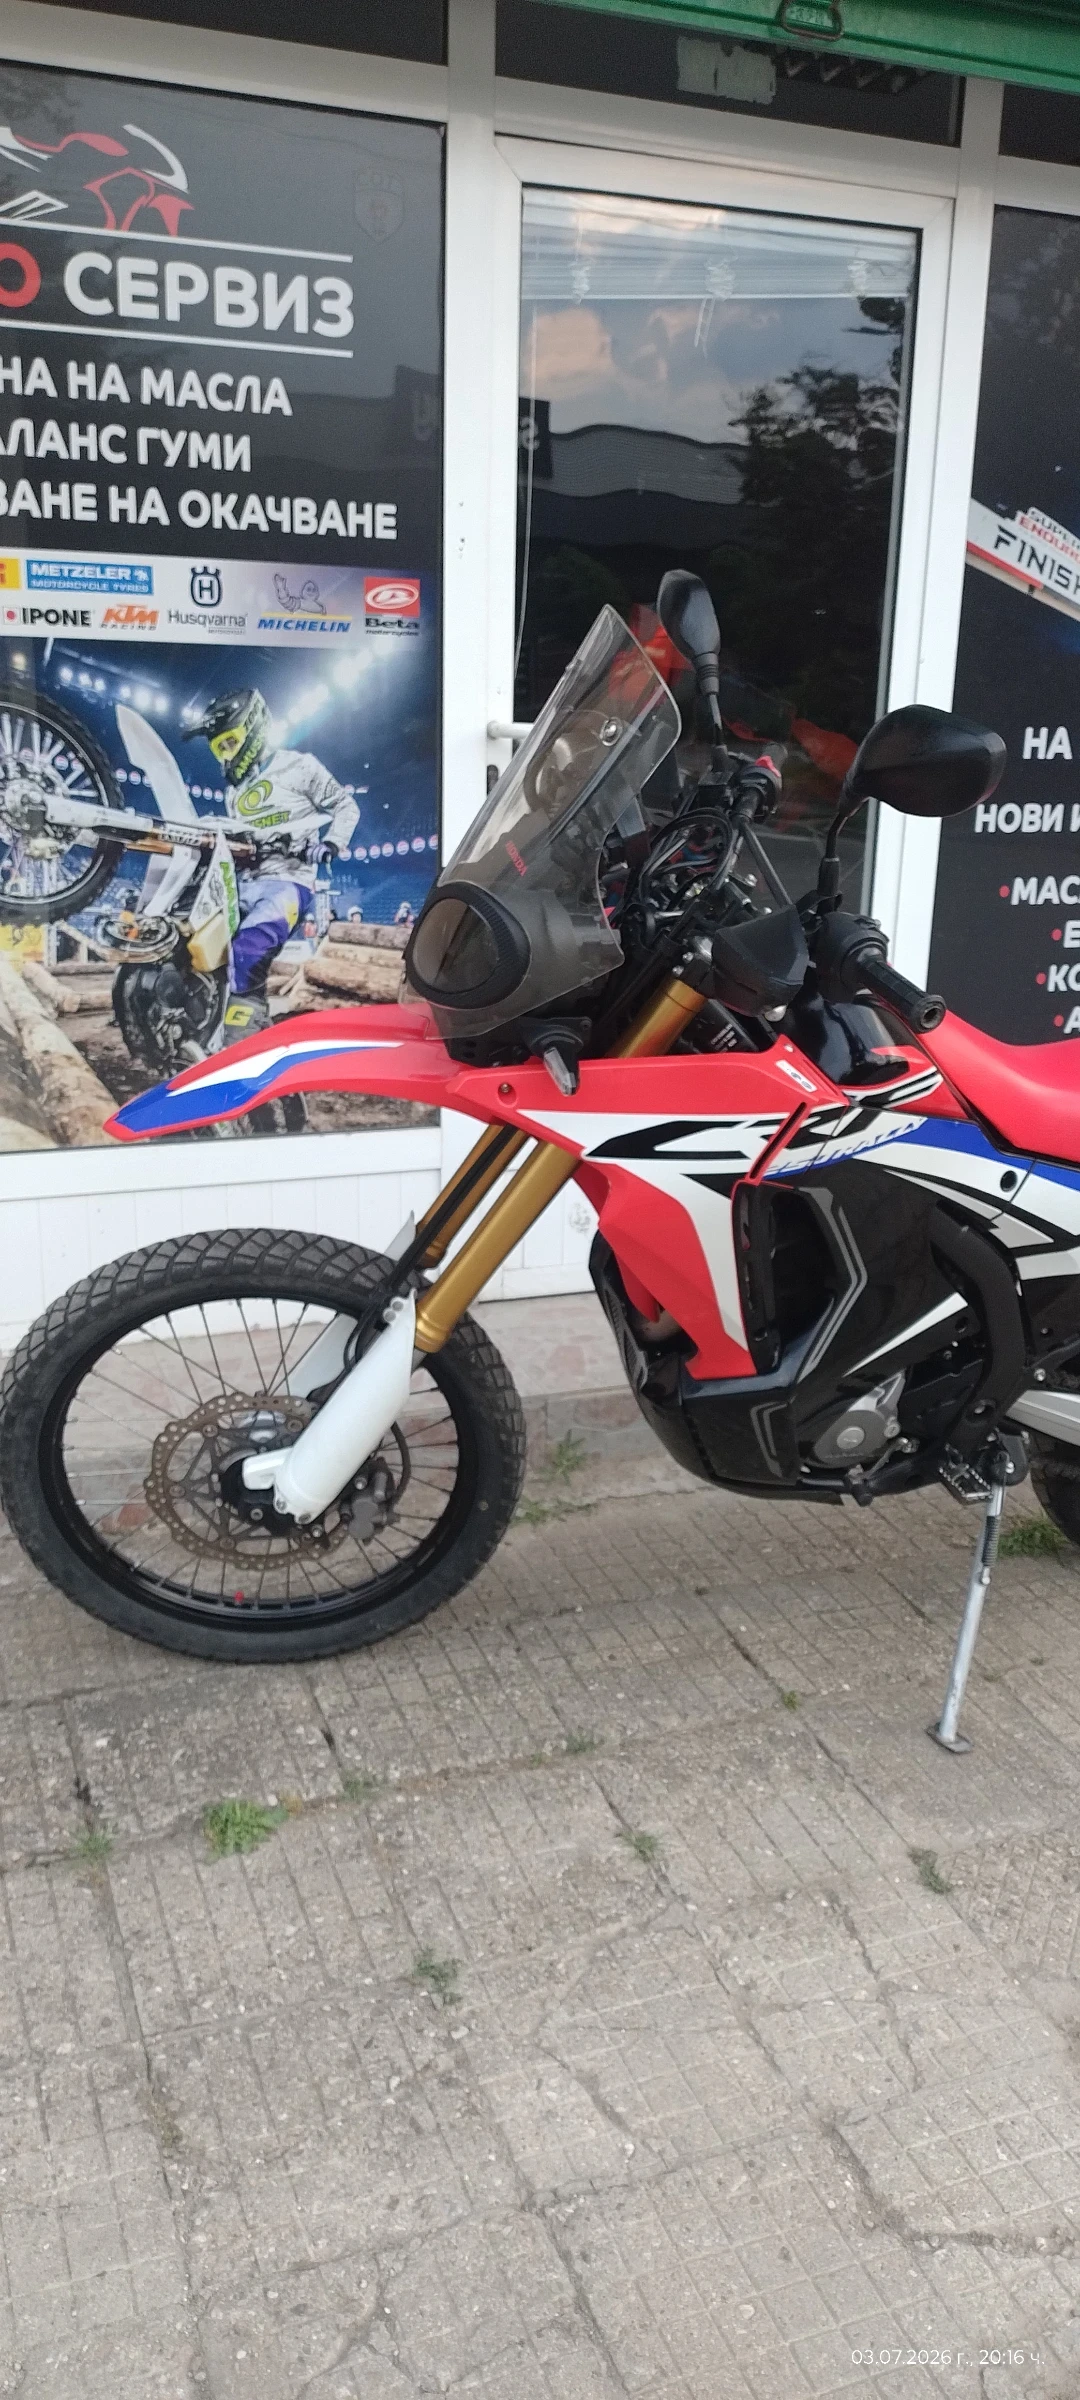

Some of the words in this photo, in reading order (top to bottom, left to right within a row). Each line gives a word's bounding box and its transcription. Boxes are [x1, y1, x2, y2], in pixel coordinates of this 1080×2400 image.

[63, 251, 355, 338] СЕРВИЗ
[67, 360, 131, 404] НА
[140, 367, 293, 417] МАСЛА
[137, 426, 252, 473] ГУМИ
[108, 485, 170, 527] НА
[179, 489, 398, 540] ОКАЧВАНЕ
[30, 562, 132, 581] METZELER
[22, 607, 92, 627] IPONE
[103, 603, 160, 624] KTM
[167, 608, 247, 627] Husqvarna
[257, 618, 351, 633] MICHELIN
[365, 617, 420, 629] Beta
[1022, 725, 1073, 760] НА
[974, 803, 1065, 834] НОВИ
[504, 840, 528, 877] HONDA
[1010, 874, 1080, 906] МАС
